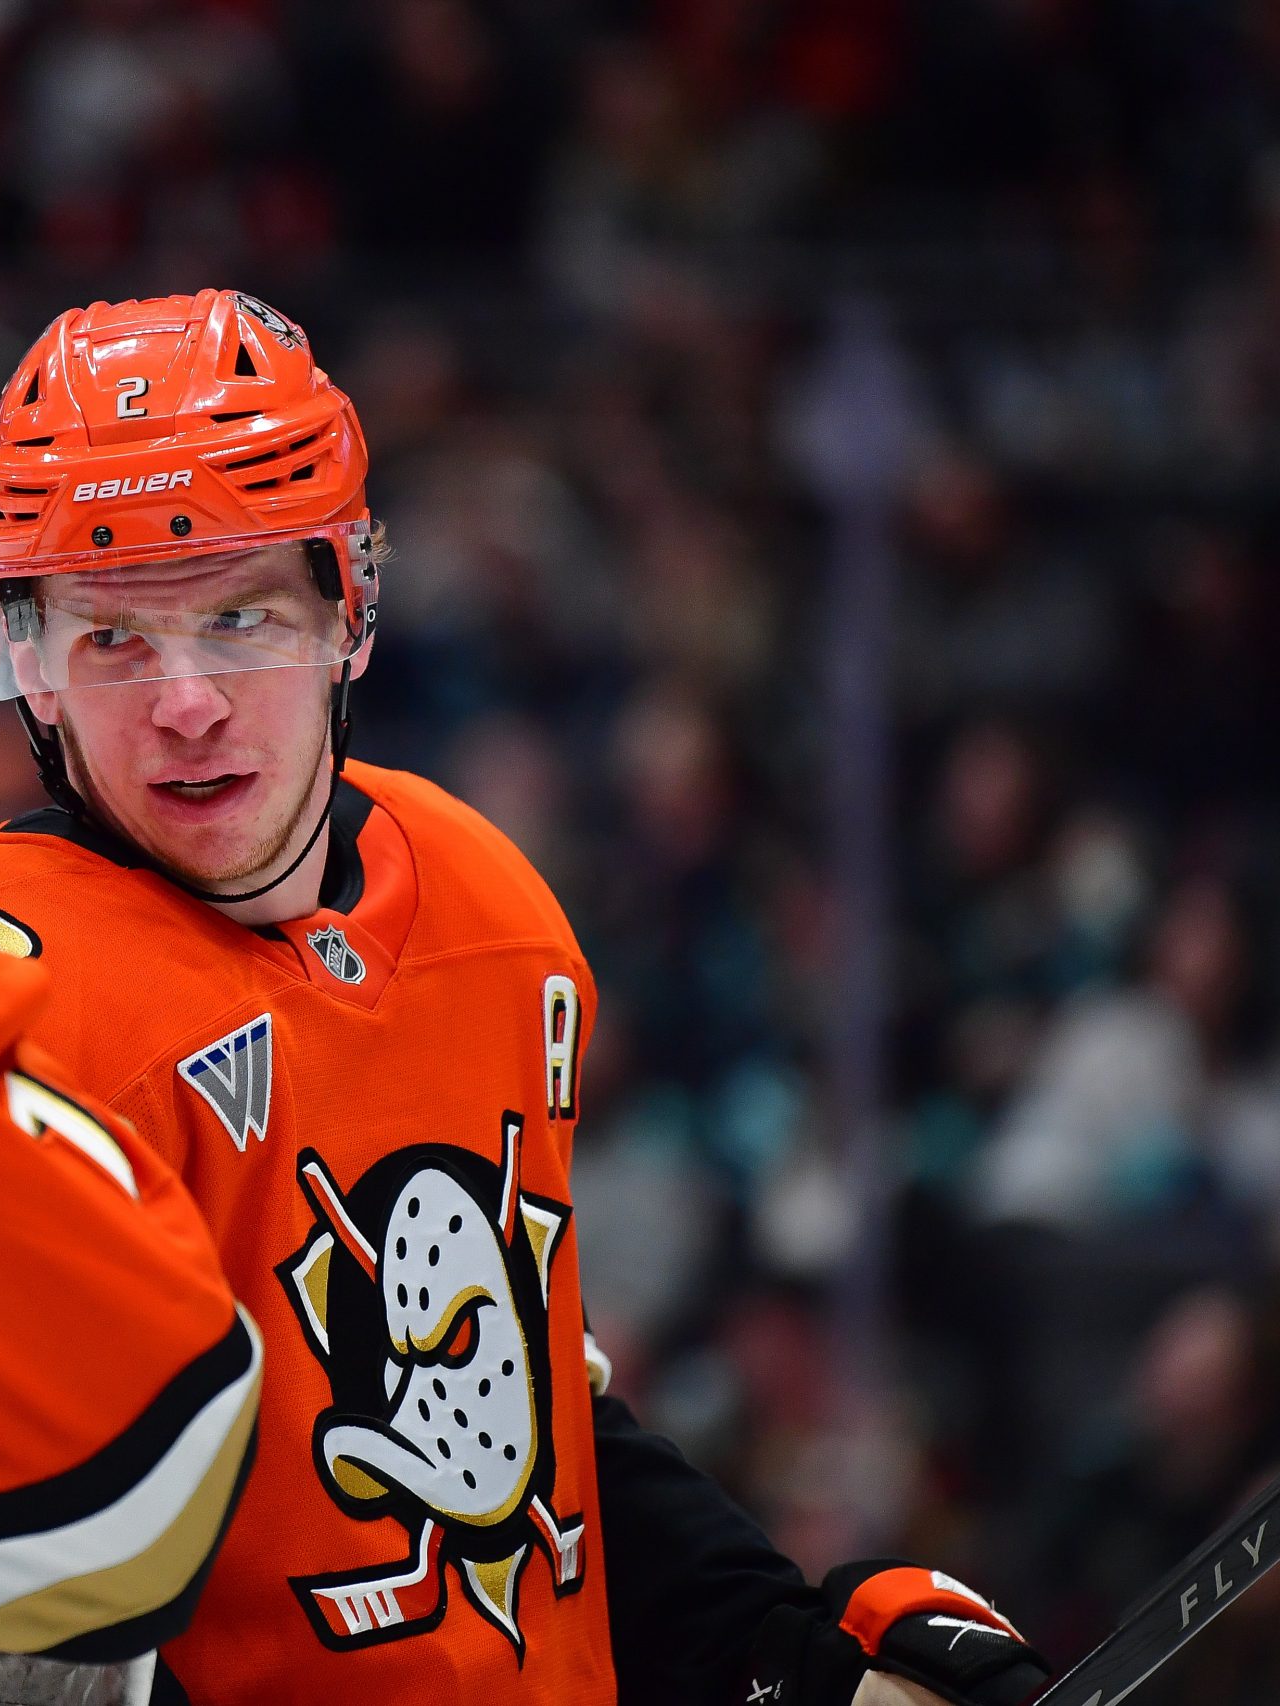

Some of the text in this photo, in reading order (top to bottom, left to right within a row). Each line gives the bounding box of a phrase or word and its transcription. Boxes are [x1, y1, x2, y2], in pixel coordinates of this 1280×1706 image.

[116, 376, 148, 419] 2
[72, 469, 193, 502] BAUER
[545, 975, 582, 1120] A
[1178, 1519, 1268, 1632] FLY
